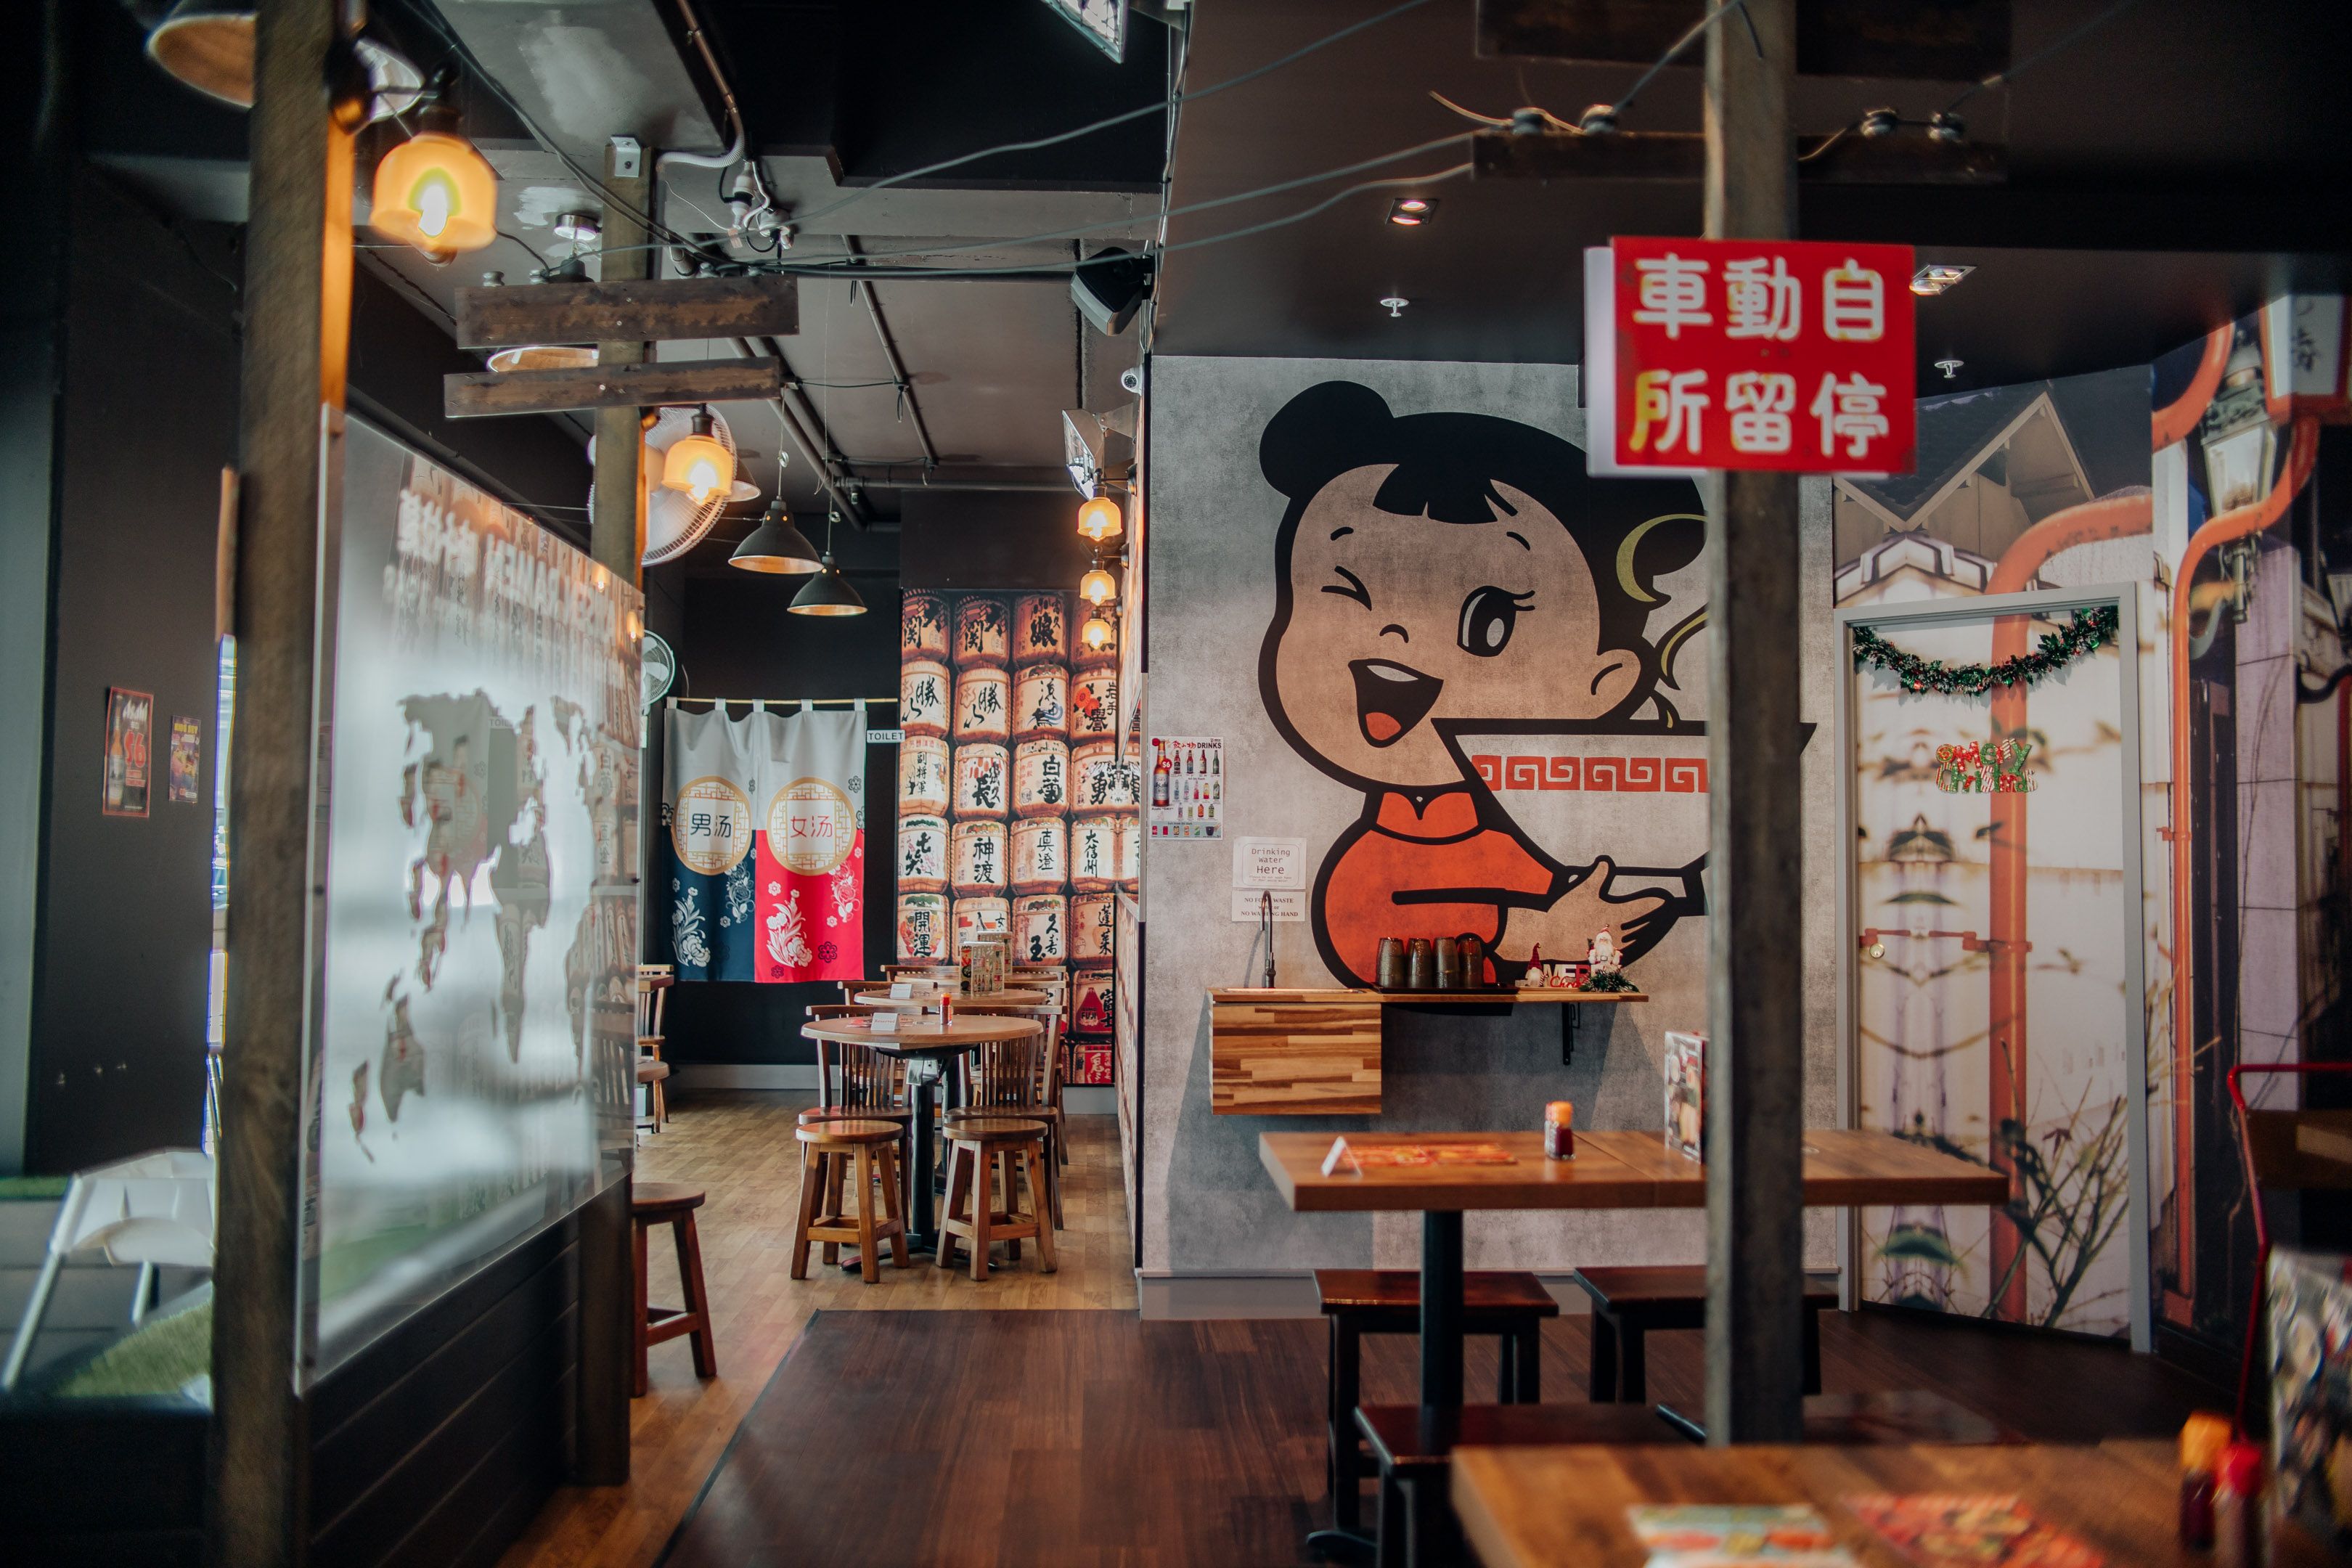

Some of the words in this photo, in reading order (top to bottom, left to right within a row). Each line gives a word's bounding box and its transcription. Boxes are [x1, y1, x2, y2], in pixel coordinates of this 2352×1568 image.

[868, 732, 904, 740] TOILET
[1251, 848, 1291, 857] Drinking
[1257, 865, 1284, 875] Here
